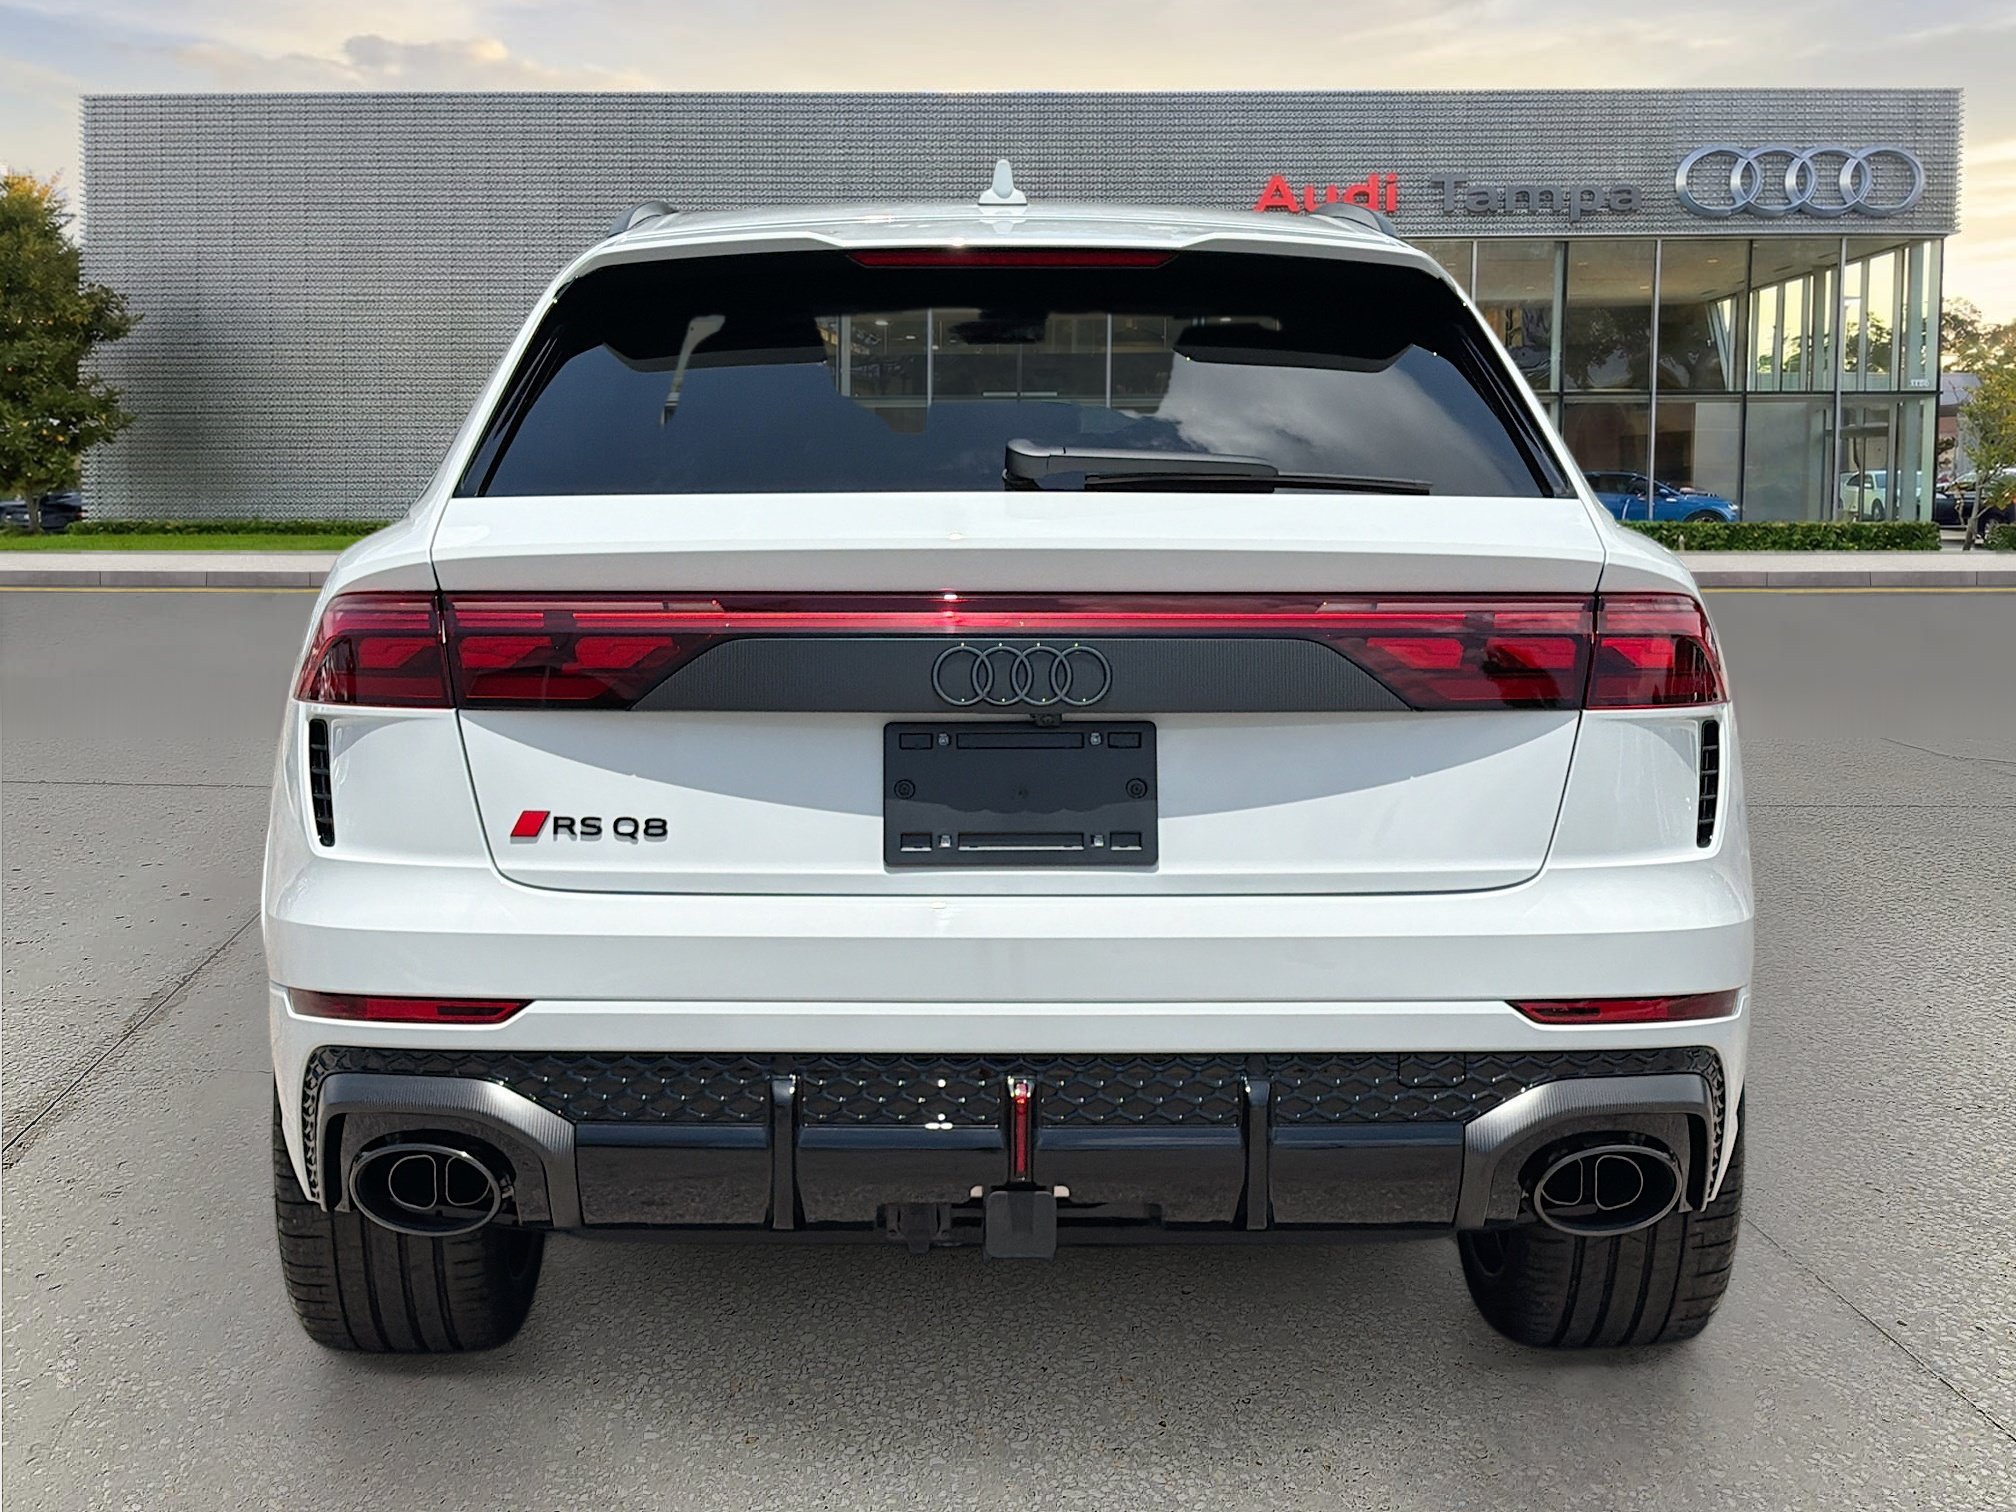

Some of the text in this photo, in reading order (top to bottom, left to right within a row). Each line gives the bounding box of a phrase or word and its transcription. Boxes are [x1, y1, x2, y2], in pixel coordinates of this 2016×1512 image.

[1254, 173, 1641, 223] Audi Tampa
[553, 816, 668, 844] RS Q8
